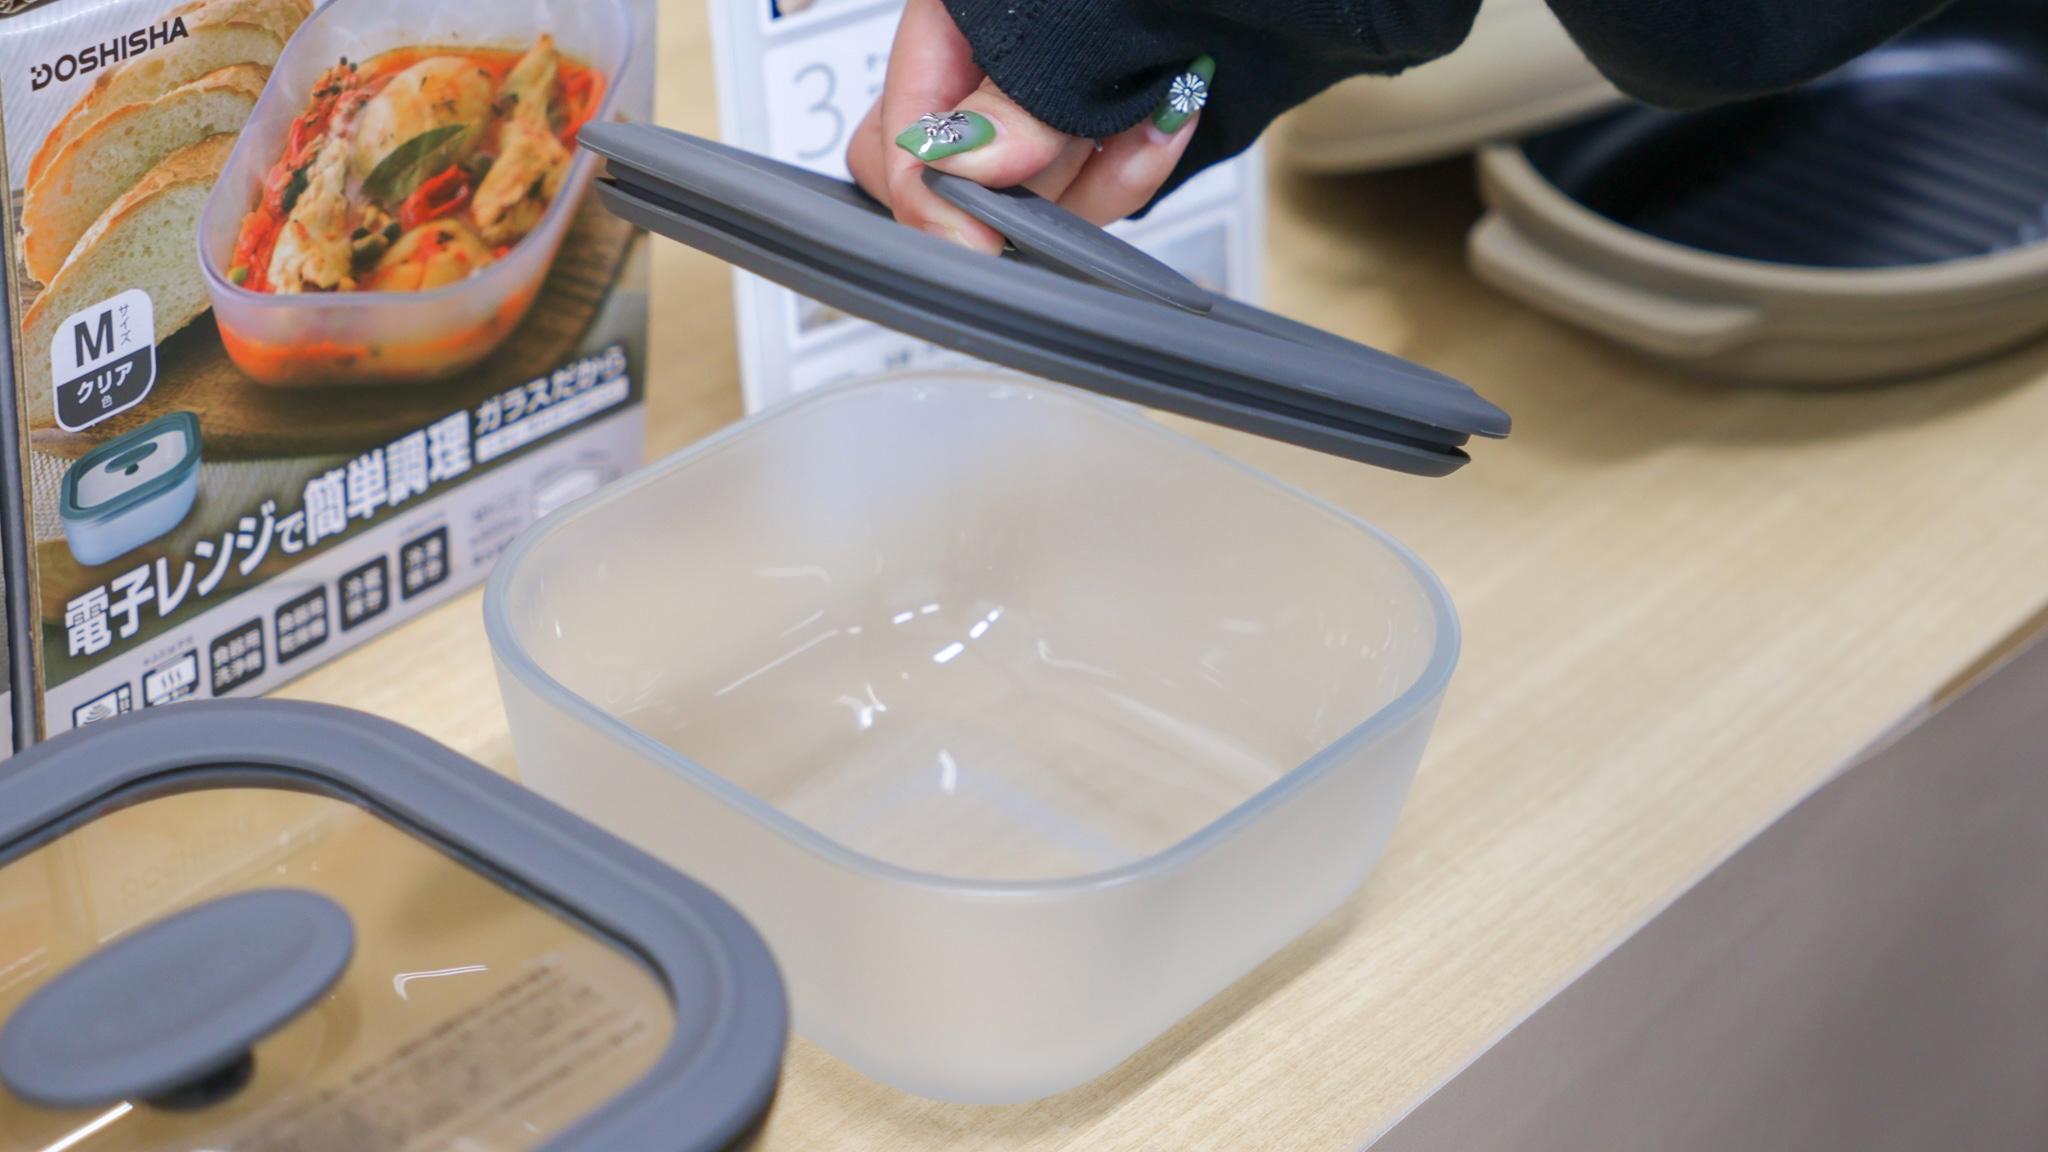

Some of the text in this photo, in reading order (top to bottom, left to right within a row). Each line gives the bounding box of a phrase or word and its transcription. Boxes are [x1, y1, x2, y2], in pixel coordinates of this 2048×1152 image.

[31, 16, 189, 91] DOSHISHA
[794, 62, 845, 160] 3
[74, 309, 115, 368] M
[119, 304, 132, 346] サイズ
[77, 361, 133, 404] クリア
[475, 345, 627, 435] ガラスだから
[65, 410, 473, 657] 電子レンジで簡単調理
